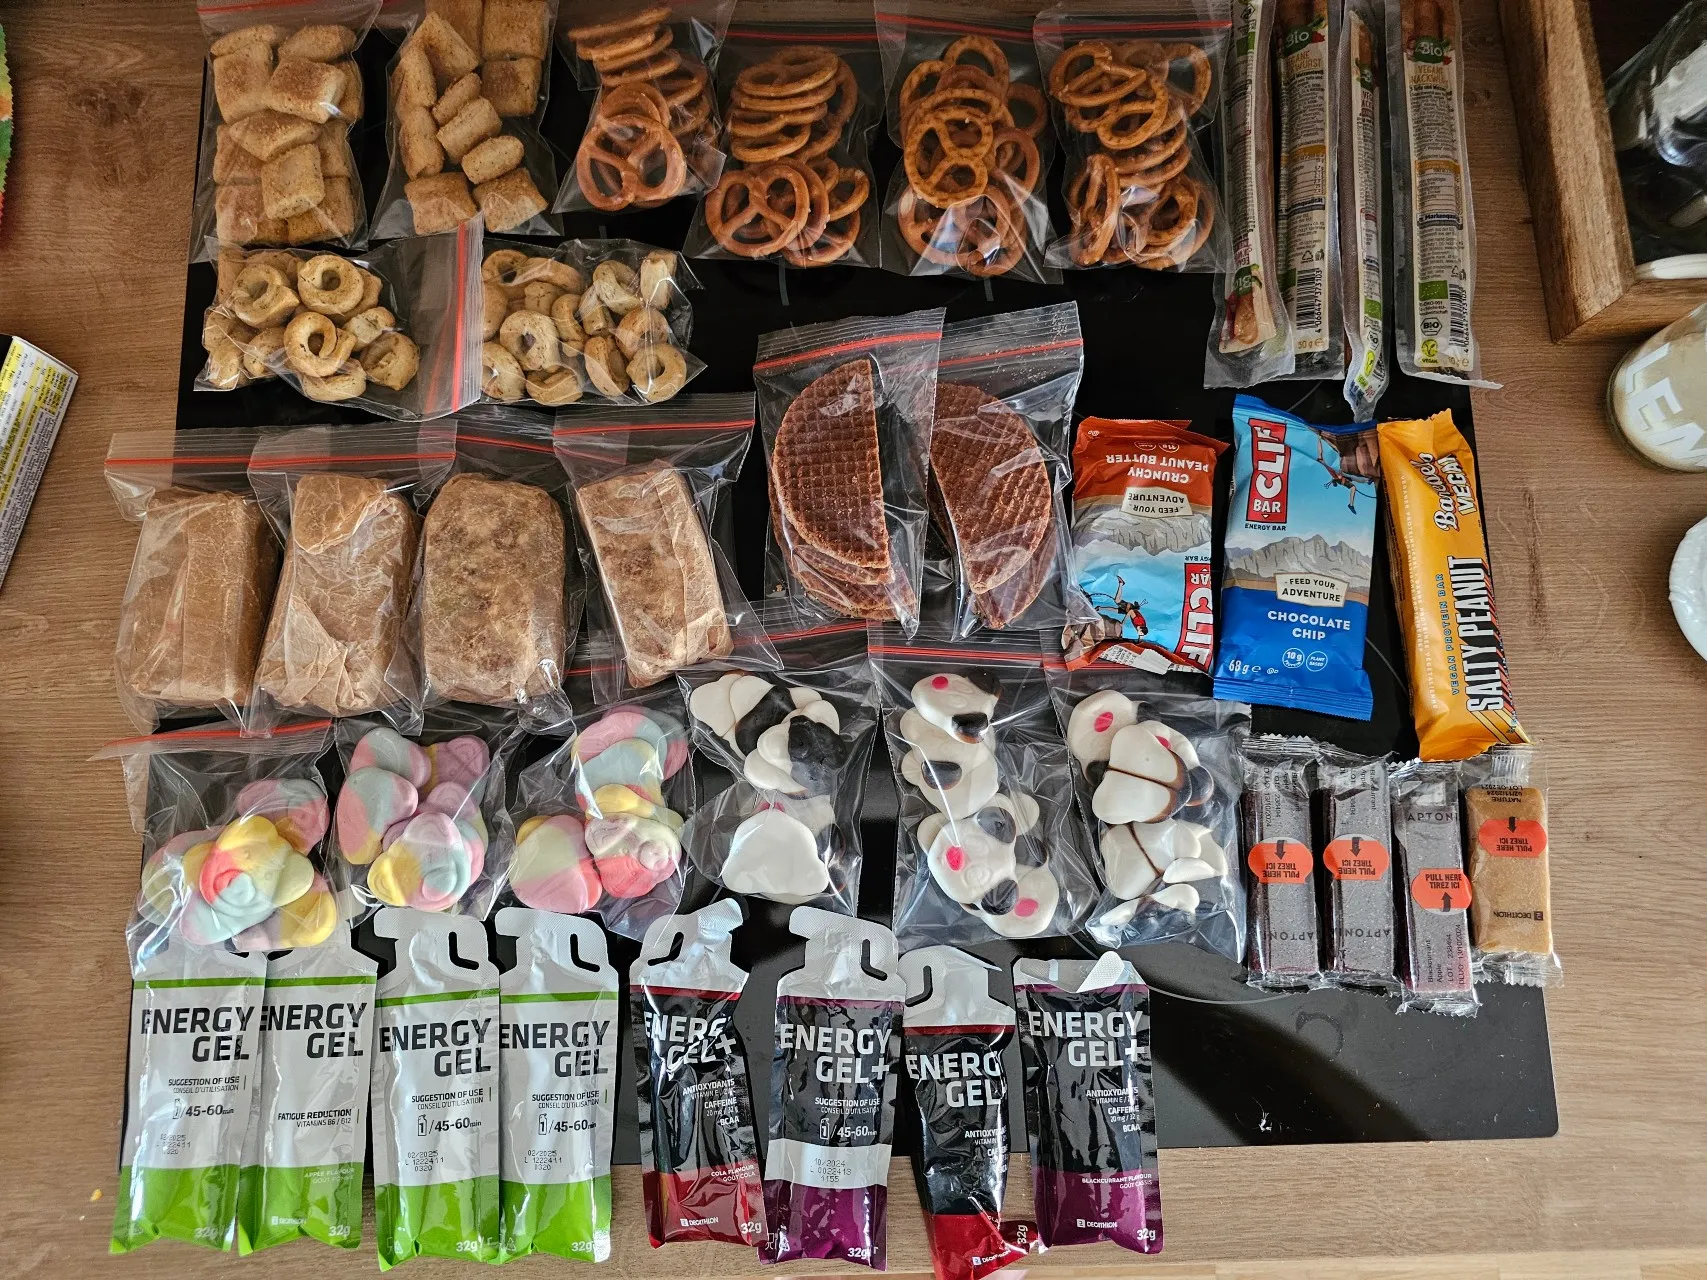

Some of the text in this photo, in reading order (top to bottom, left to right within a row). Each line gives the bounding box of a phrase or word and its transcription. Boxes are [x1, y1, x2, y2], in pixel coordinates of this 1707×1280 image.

[1105, 454, 1209, 472] PEANUT BUTTER
[1254, 426, 1285, 499] CLIF
[1127, 466, 1189, 484] CRUNCHY
[1128, 493, 1185, 503] ADVENTURE
[1133, 505, 1179, 513] FEED YOUR
[1253, 498, 1281, 513] BAR
[1244, 522, 1270, 530] ENERGY
[1313, 579, 1336, 590] YOUR
[1282, 588, 1341, 602] ADVENTURE
[1267, 610, 1351, 631] CHOCOLATE
[1292, 627, 1326, 641] CHIP
[1435, 573, 1460, 695] VEGAN PROTEIN BAR
[1447, 556, 1504, 712] SALTY PEANUT
[1228, 660, 1249, 675] 68 g
[1282, 870, 1300, 878] PULL
[1445, 873, 1462, 881] HERE
[1429, 881, 1460, 889] TIREZ ICI
[1027, 1011, 1143, 1038] ENERGY
[379, 1018, 492, 1052] ENERGY
[500, 1021, 611, 1049] ENERGY
[780, 1023, 893, 1055] ENERGY
[191, 1035, 250, 1062] GEL
[306, 1031, 364, 1059] GEL
[1067, 1038, 1146, 1067] GEL+
[434, 1047, 492, 1077] GEL
[554, 1048, 609, 1077] GEL
[815, 1055, 890, 1084] GEL+
[168, 1075, 240, 1087] SUGGESTION OF USE
[682, 1078, 735, 1096] ANTIOXYDANTS
[411, 1088, 483, 1102] SUGGESTION OF USE
[532, 1090, 600, 1102] SUGGESTION OF USE
[815, 1097, 858, 1107] SUGGESTION
[868, 1097, 881, 1105] USE
[417, 1102, 441, 1110] CONSEIL
[704, 1096, 738, 1109] CAFFEINE
[277, 1108, 352, 1121] FATIGUE REDUCTION
[1107, 1105, 1140, 1115] CAFFEINE
[720, 1115, 740, 1125] BCAA
[1122, 1123, 1141, 1132] BCAA
[407, 1150, 438, 1158] 02/2025
[727, 1164, 755, 1176] FLAVOUR
[328, 1224, 351, 1238] 32g
[741, 1221, 762, 1235] 32g
[1086, 1221, 1118, 1229] DECATHLON
[1016, 1224, 1028, 1244] 32g
[1136, 1228, 1156, 1241] 32g
[456, 1241, 478, 1252] 32g
[571, 1240, 594, 1252] 32g
[847, 1247, 868, 1258] 32g
